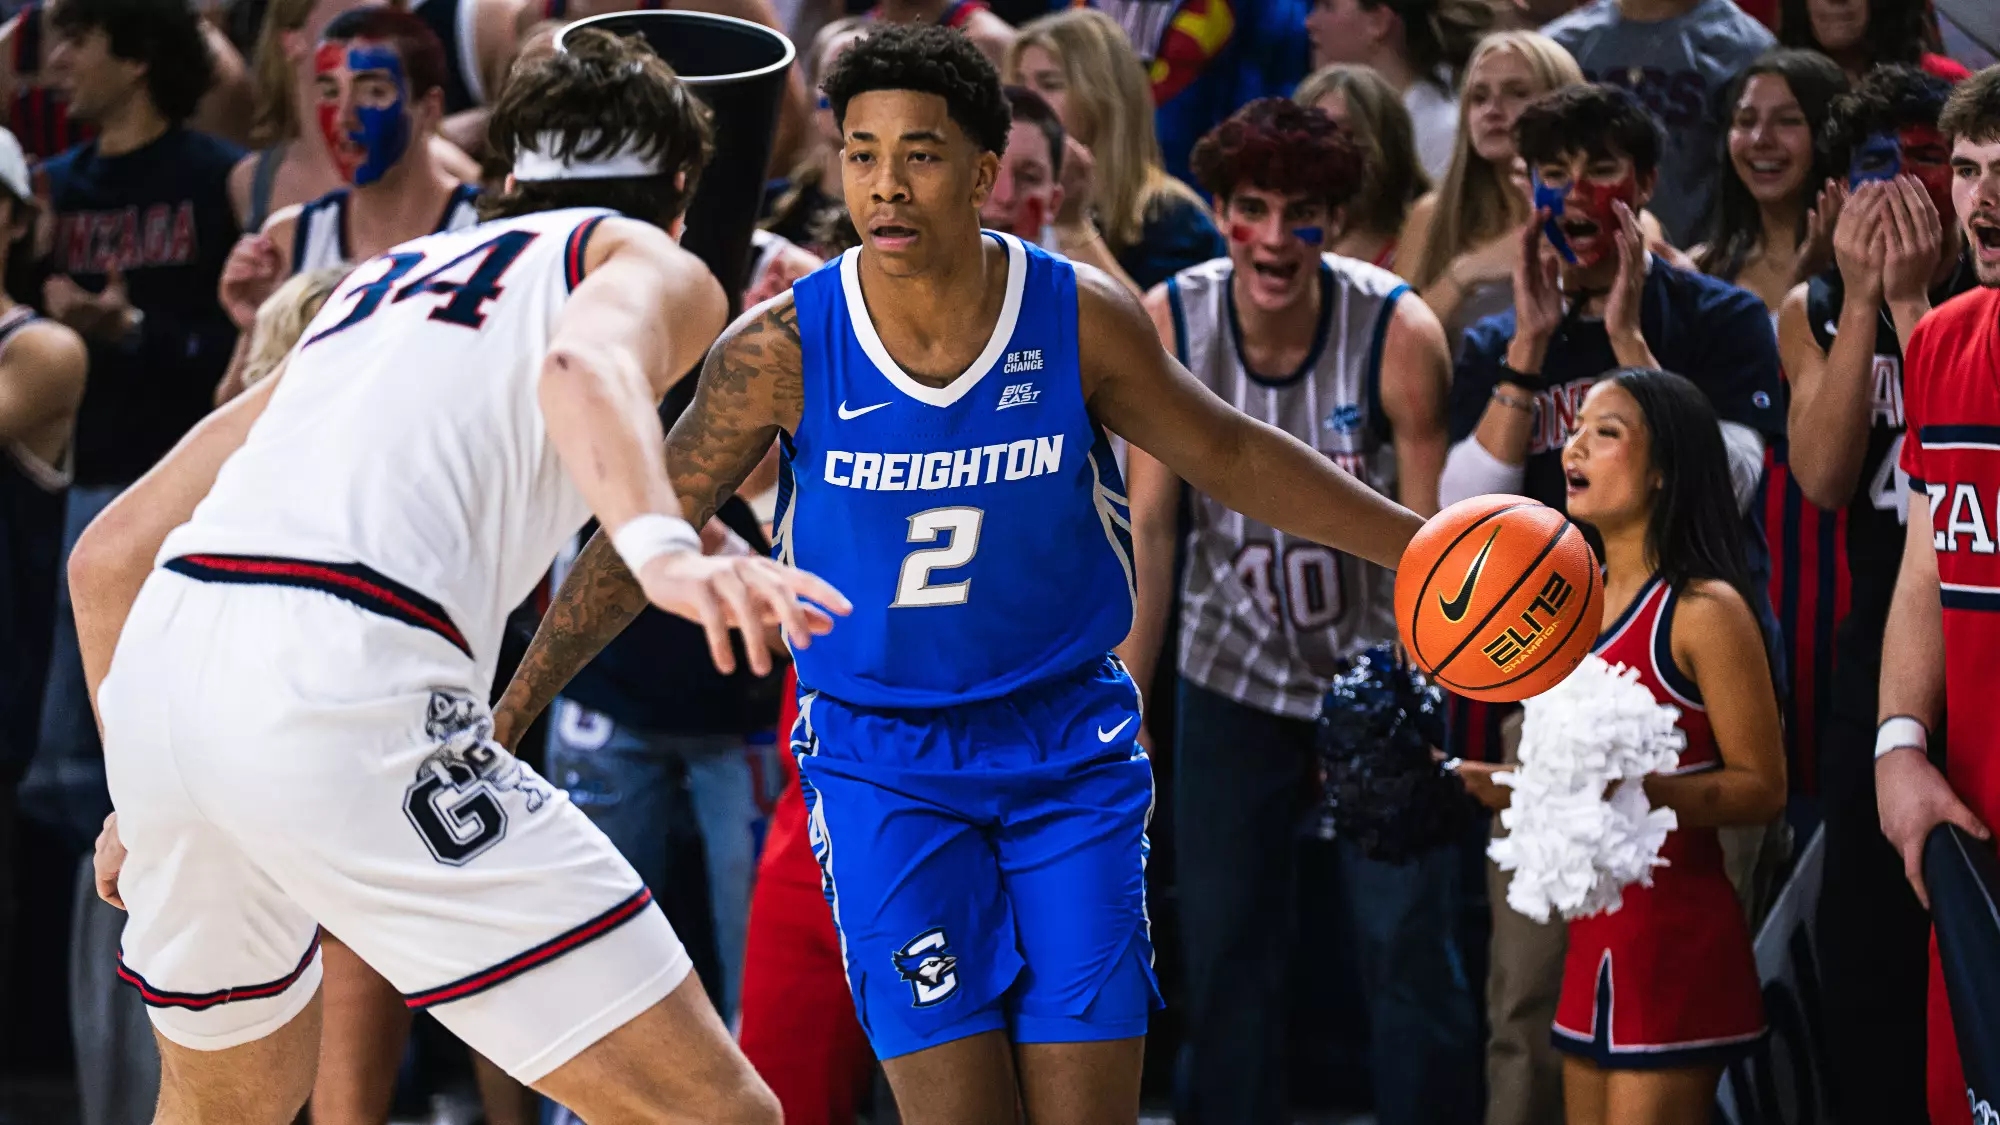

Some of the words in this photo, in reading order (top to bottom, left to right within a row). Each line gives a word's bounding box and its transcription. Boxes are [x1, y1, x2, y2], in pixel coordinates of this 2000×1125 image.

[300, 229, 541, 351] 34
[1003, 359, 1044, 374] CHANGE
[1007, 351, 1021, 363] BE
[1022, 349, 1042, 361] THE
[998, 390, 1042, 406] EAST
[1002, 382, 1033, 396] BIG
[824, 434, 1065, 491] CREIGHTON
[1925, 483, 2000, 554] ZA
[888, 505, 985, 609] 2
[1481, 570, 1573, 668] ELITE
[402, 760, 509, 867] G
